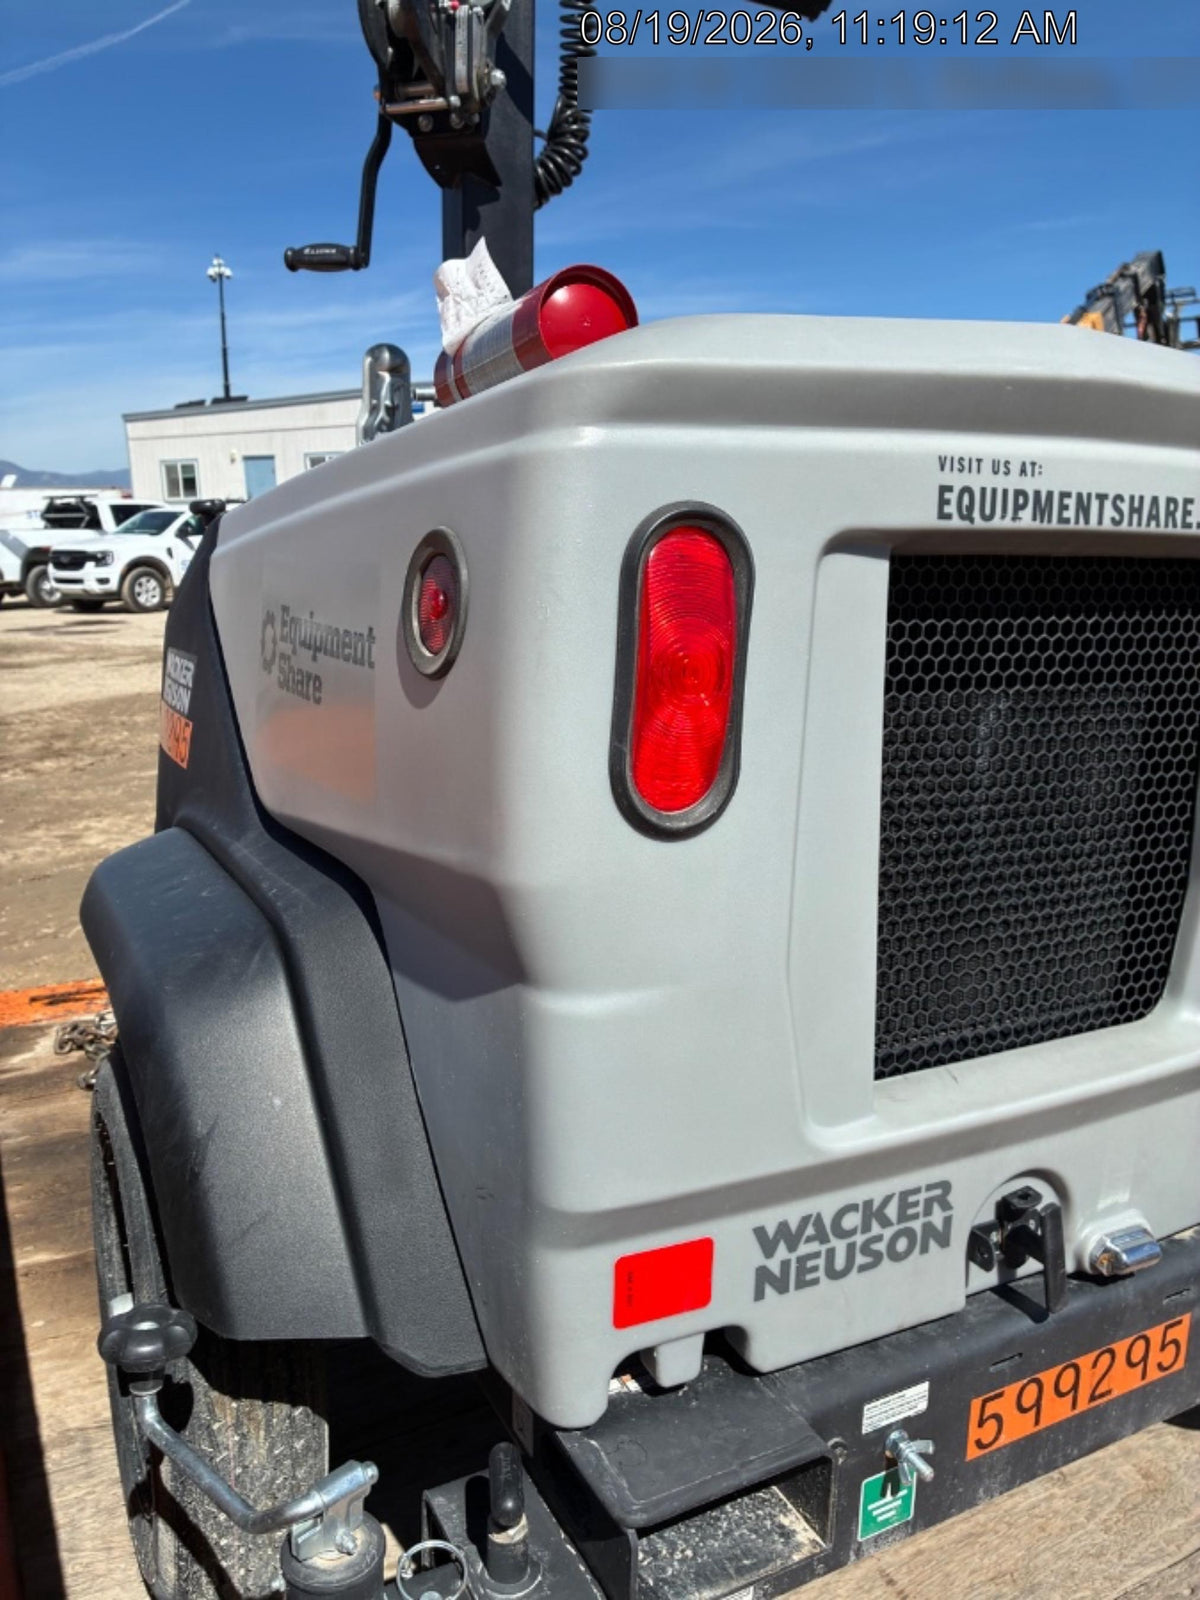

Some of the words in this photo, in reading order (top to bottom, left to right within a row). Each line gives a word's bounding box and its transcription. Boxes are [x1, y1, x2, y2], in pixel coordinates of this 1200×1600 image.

[938, 455, 983, 474] VISIT
[992, 460, 1011, 476] US
[1019, 461, 1043, 477] AT:
[280, 604, 376, 669] Equipment
[752, 1180, 953, 1259] WACKER
[753, 1214, 953, 1302] NEUSON
[973, 1318, 1184, 1451] 599295
